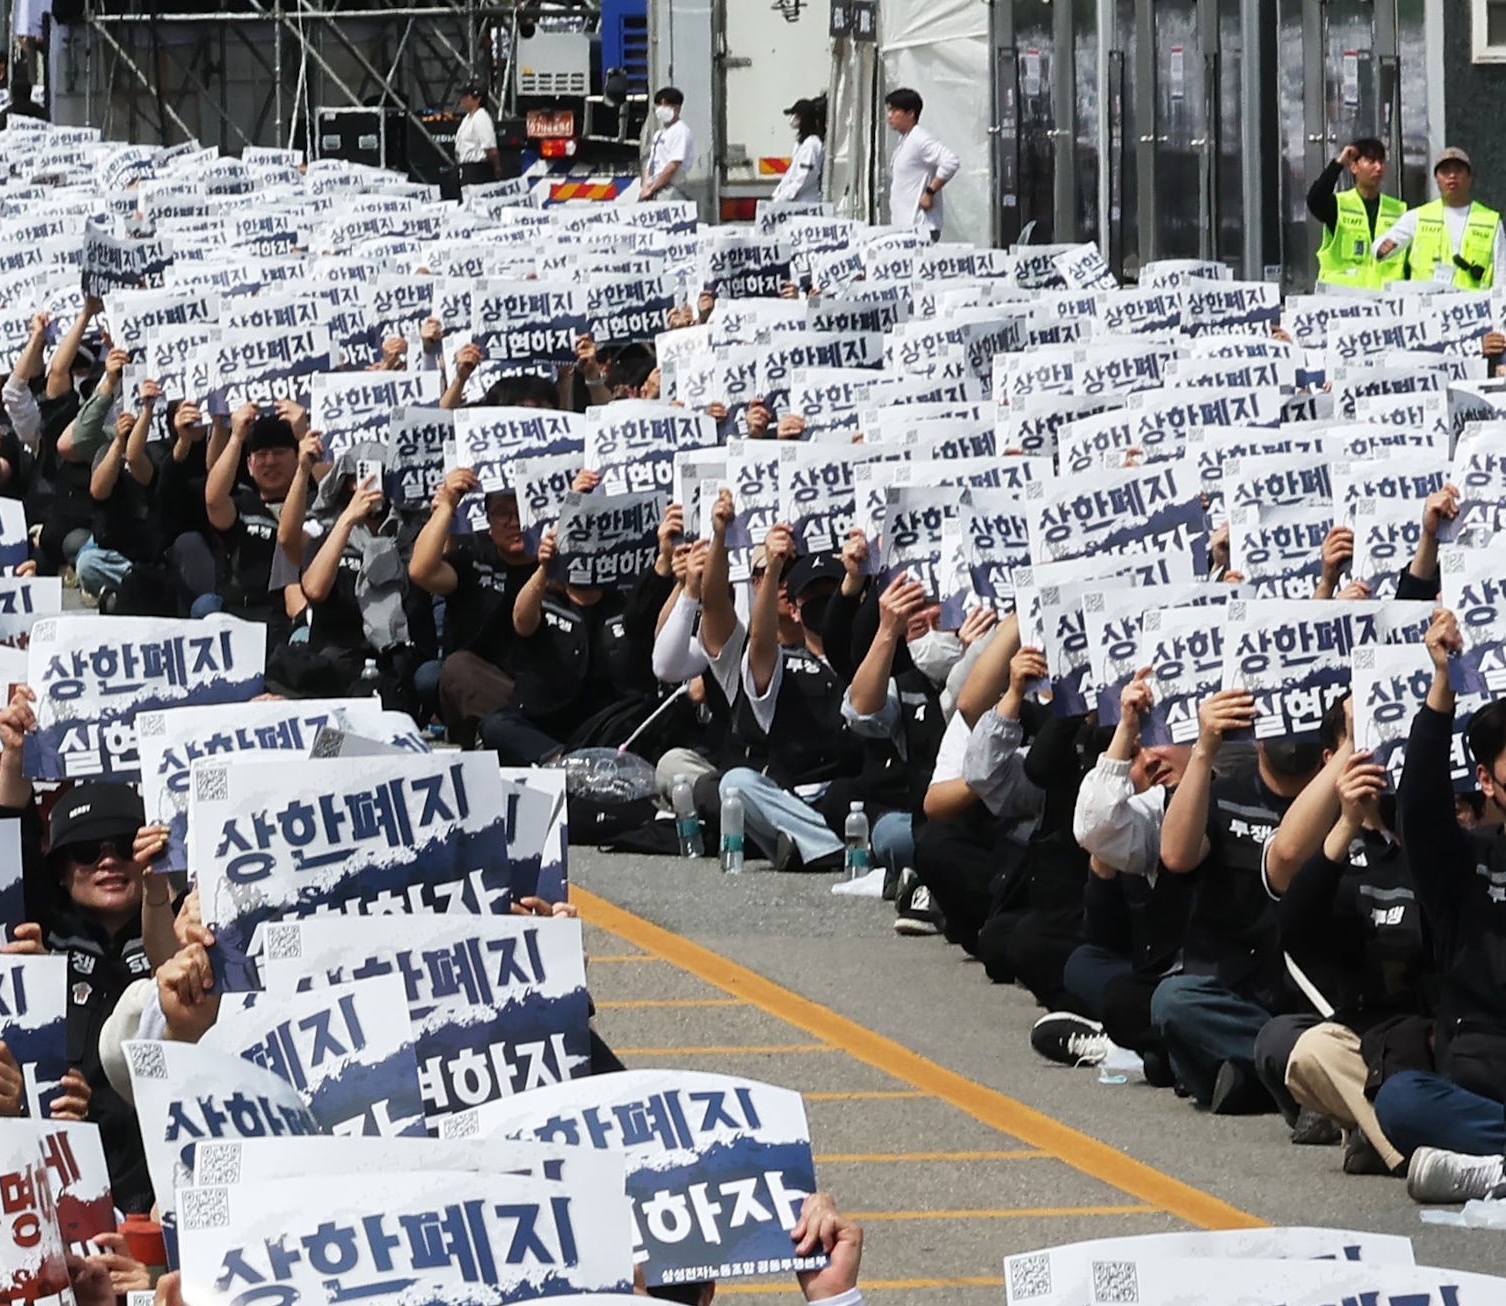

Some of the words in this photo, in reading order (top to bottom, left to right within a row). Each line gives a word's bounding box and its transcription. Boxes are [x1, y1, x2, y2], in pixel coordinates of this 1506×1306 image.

[709, 247, 781, 271] 상한폐지
[918, 256, 995, 281] 상한폐지
[479, 286, 574, 320] 상한폐지
[586, 277, 663, 309] 상한폐지
[1104, 291, 1181, 328] 상한폐지
[1188, 287, 1266, 316] 상한폐지
[486, 329, 582, 362] 실현하자
[589, 309, 670, 342] 실현하자
[1337, 322, 1428, 360] 상한폐지
[216, 331, 316, 374] 상한폐지
[763, 336, 868, 379] 상한폐지
[321, 377, 423, 420] 상한폐지
[465, 416, 570, 453] 상한폐지
[594, 413, 703, 455] 상한폐지
[1139, 393, 1260, 446] 상한폐지
[566, 501, 661, 541] 상한폐지
[1039, 468, 1177, 543] 상한폐지
[567, 548, 658, 585] 실현하자
[43, 631, 233, 699] 상한폐지
[1152, 626, 1225, 681] 상한
[58, 721, 139, 776] 실현
[215, 764, 468, 883] 상한폐지
[241, 995, 367, 1090] 폐지
[631, 1171, 811, 1264] 하자
[662, 1261, 753, 1283] 삼성전자노동조합
